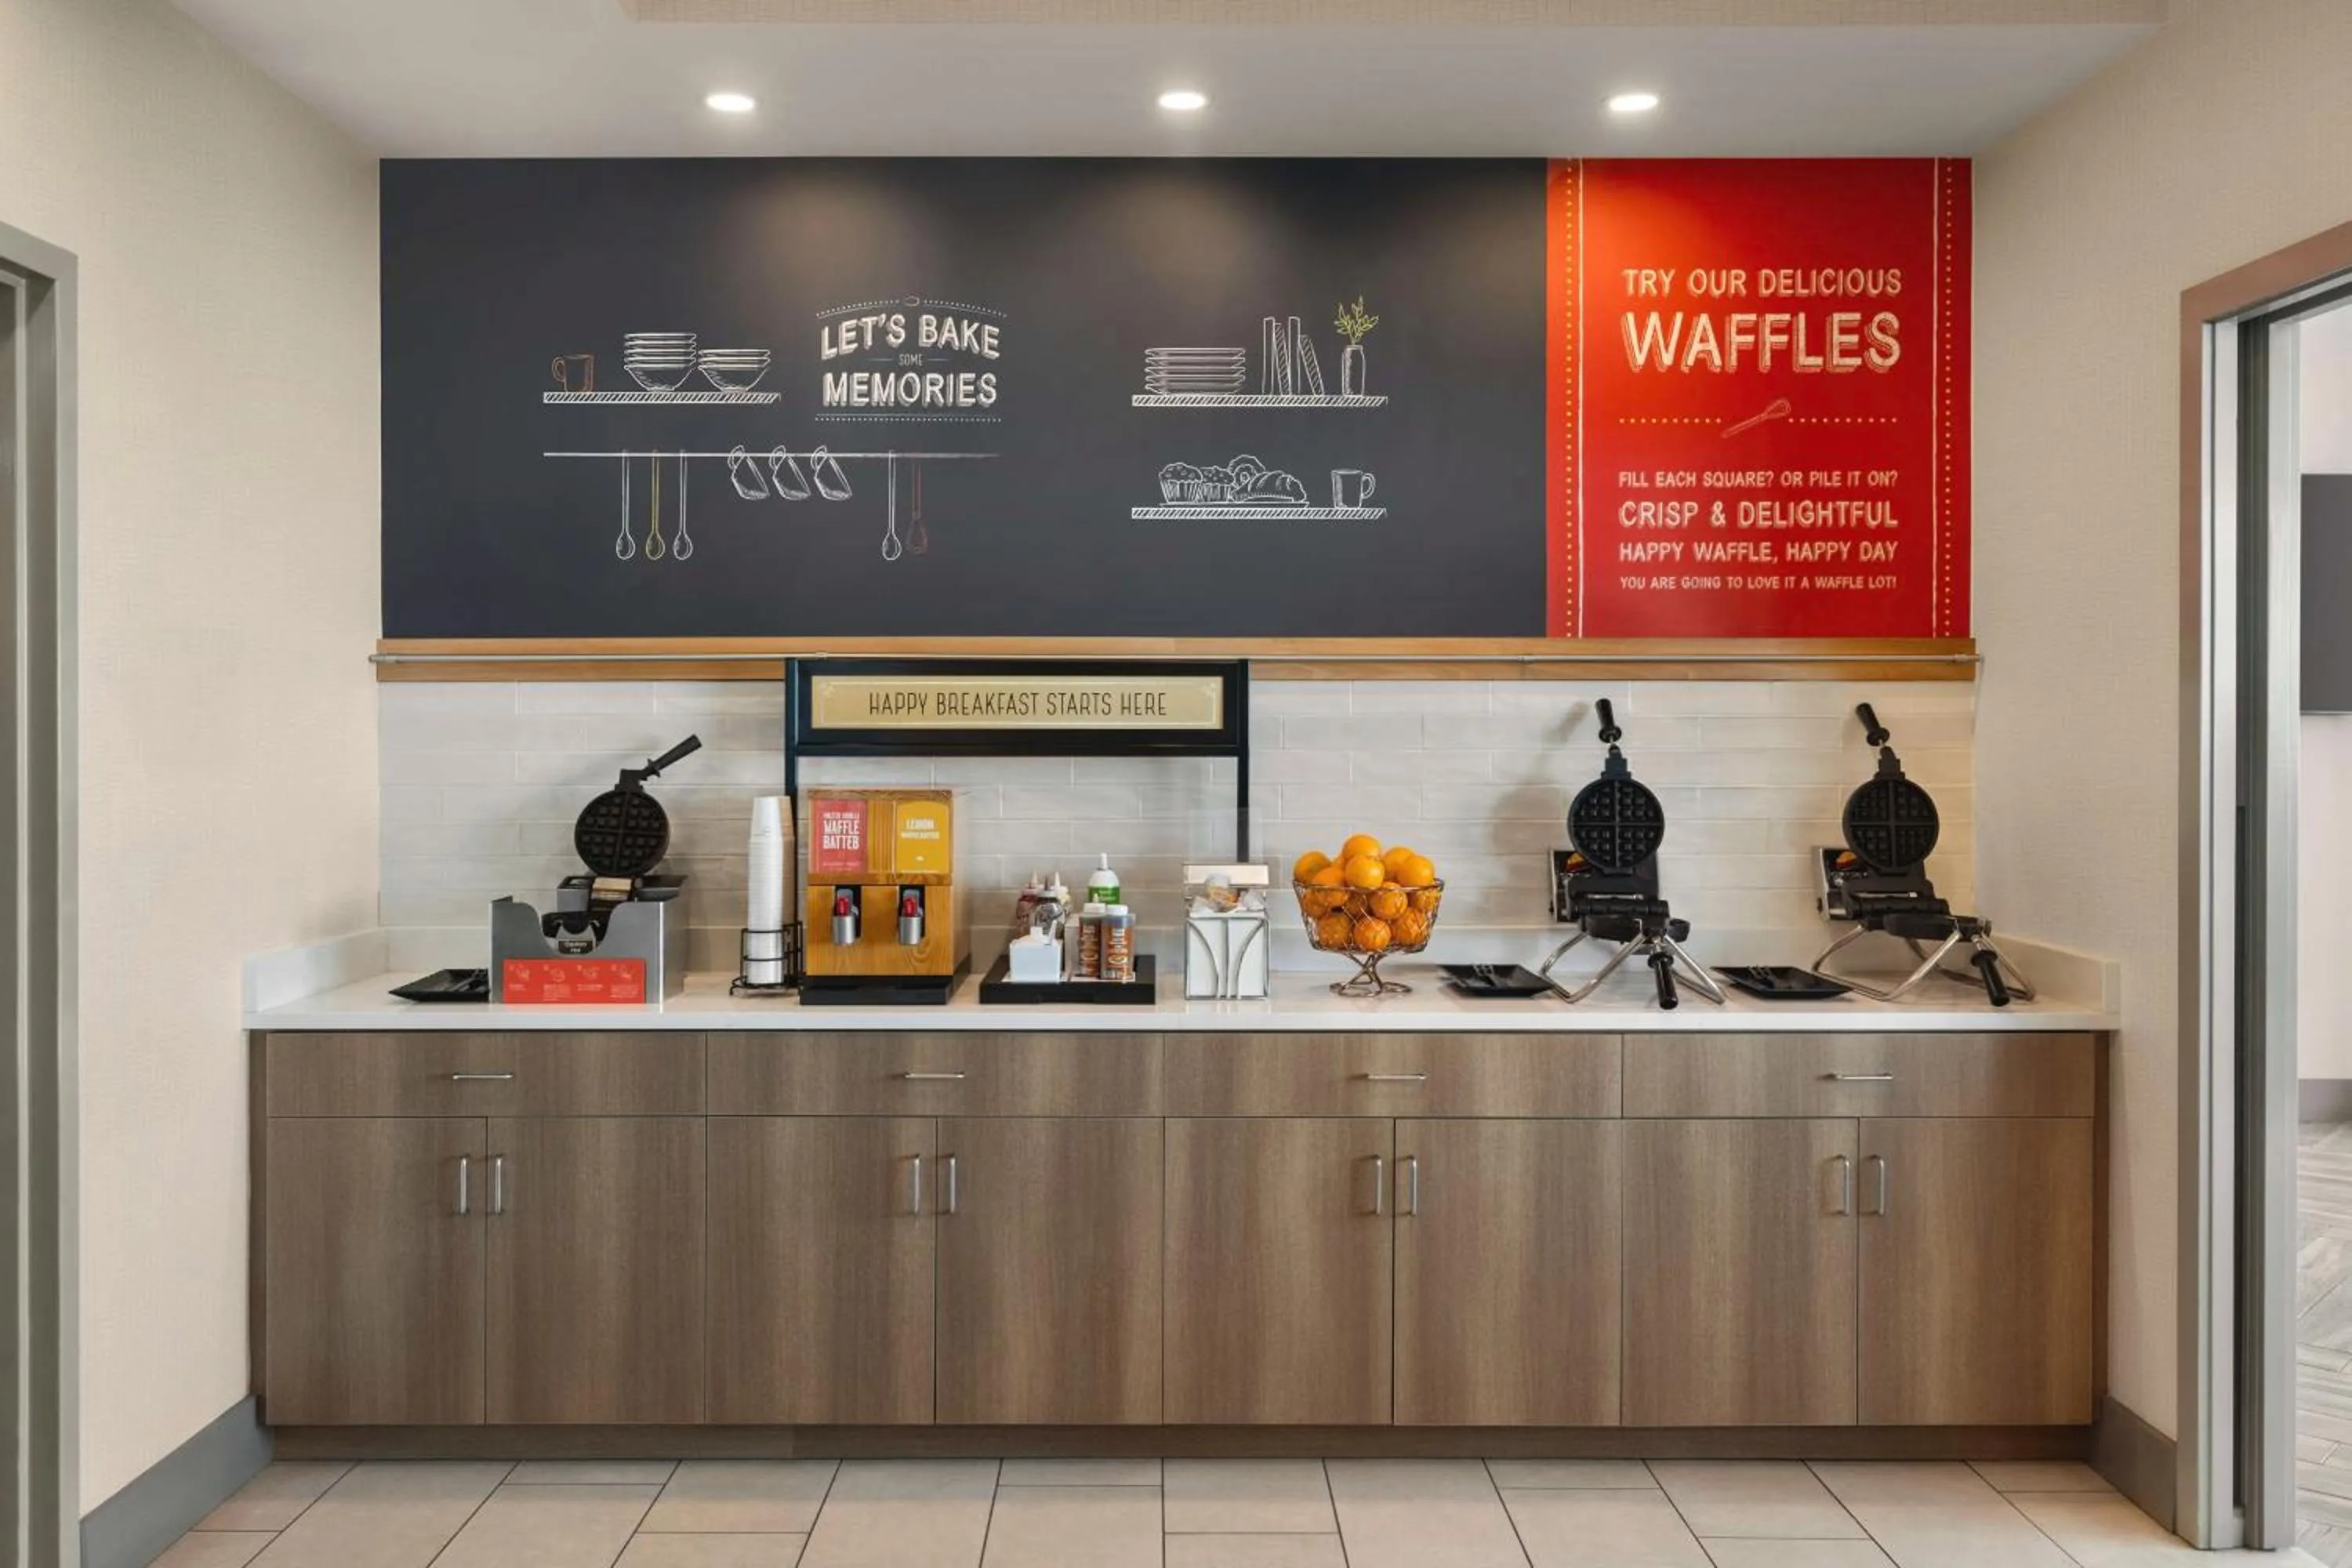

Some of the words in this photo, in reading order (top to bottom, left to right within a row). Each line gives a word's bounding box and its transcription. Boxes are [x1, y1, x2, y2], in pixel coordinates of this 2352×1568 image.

[1621, 268, 1675, 298] TRY
[1686, 268, 1747, 299] OUR
[1759, 268, 1902, 297] DELICIOUS
[820, 313, 906, 361] LET'S
[918, 314, 1001, 360] BAKE
[1621, 310, 1902, 374] WAFFLES
[898, 353, 924, 366] SOME
[822, 372, 997, 408] MEMORIES
[1618, 470, 1649, 488] FILL
[1655, 470, 1697, 488] EACH
[1702, 470, 1774, 488] SQUARE?
[1780, 471, 1803, 487] OR
[1809, 471, 1842, 487] PILE
[1848, 471, 1861, 487] IT
[1867, 470, 1898, 487] ON?
[1617, 500, 1699, 529] CRISP
[1709, 500, 1727, 528] &
[1737, 499, 1899, 528] DELIGHTFUL
[1619, 541, 1685, 563] HAPPY
[1692, 541, 1778, 564] WAFFLE,
[1786, 541, 1851, 562] HAPPY
[1860, 541, 1899, 562] DAY
[1621, 575, 1646, 590] YOU
[1650, 575, 1676, 590] ARE
[1681, 575, 1722, 590] GOING
[1726, 575, 1743, 590] TO
[1748, 575, 1780, 590] LOVE
[1784, 575, 1796, 589] IT
[1801, 576, 1809, 589] A
[1815, 575, 1864, 590] WAFFLE
[1869, 575, 1897, 590] LOT!
[869, 691, 927, 716] HAPPY
[936, 691, 1040, 717] BREAKFAST
[1047, 691, 1112, 716] STARTS
[1120, 692, 1167, 717] HERE
[823, 819, 860, 835] WAFFLE
